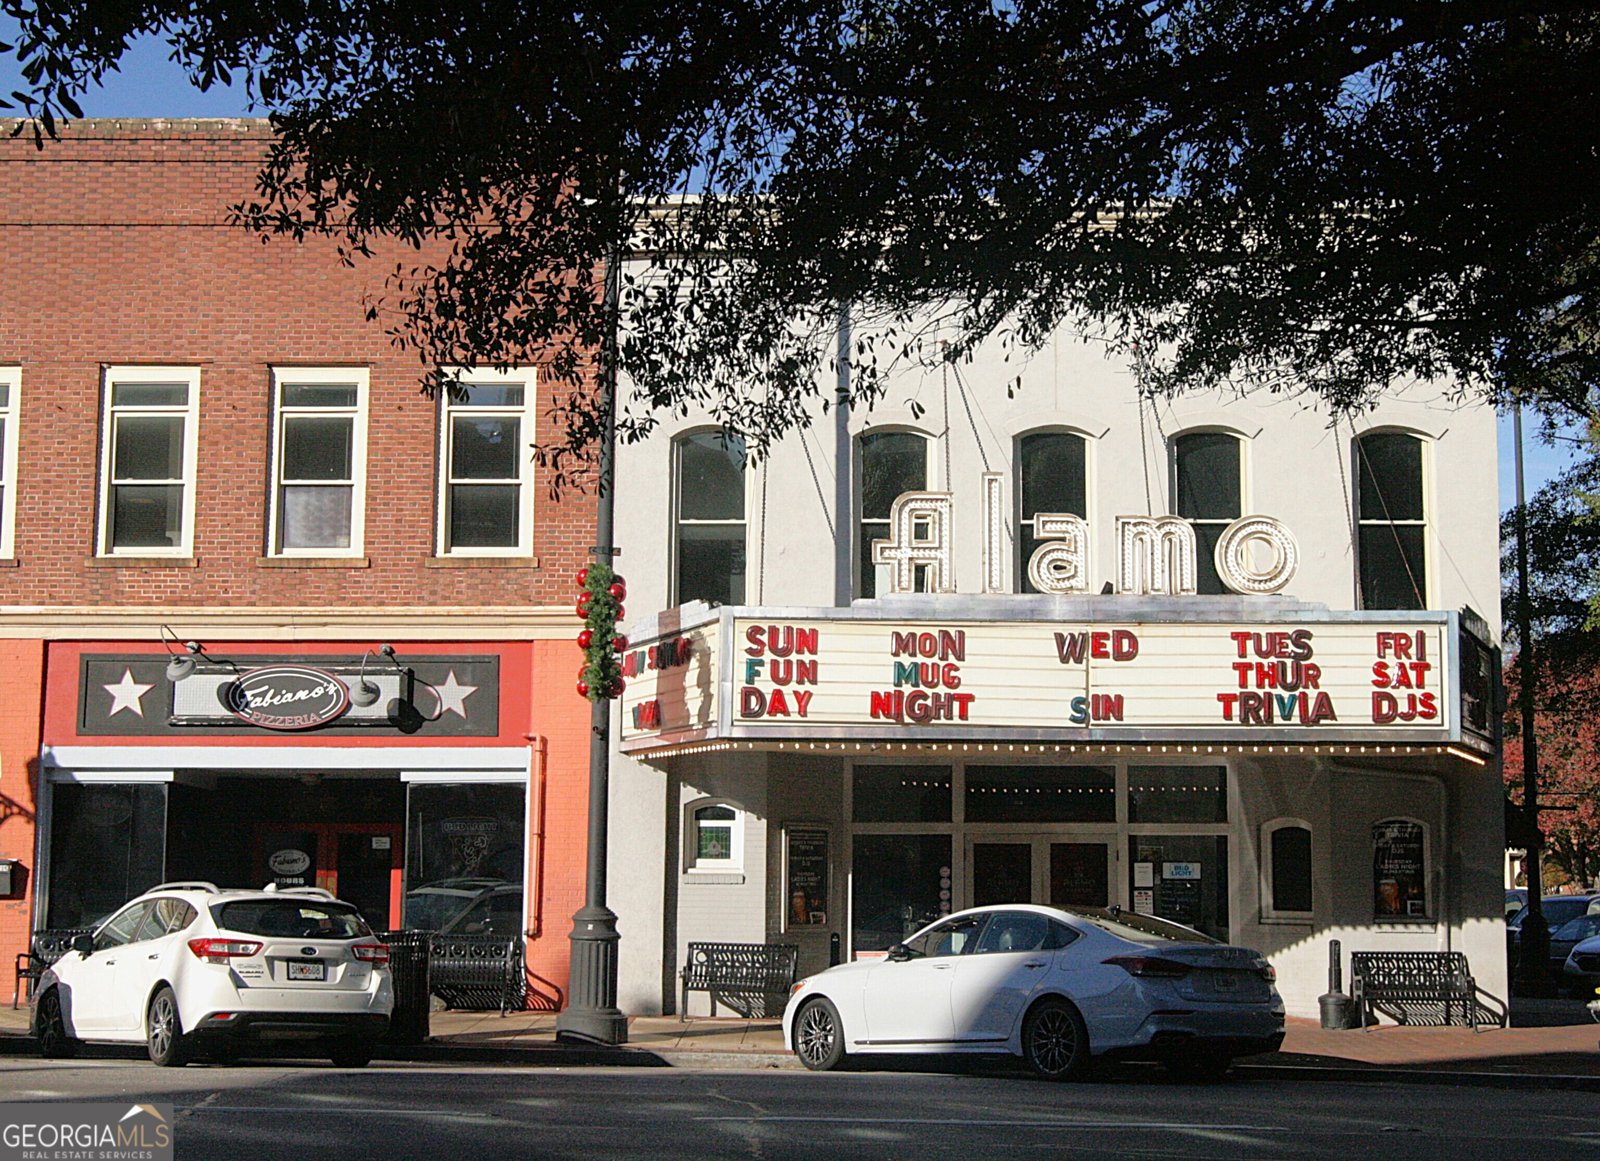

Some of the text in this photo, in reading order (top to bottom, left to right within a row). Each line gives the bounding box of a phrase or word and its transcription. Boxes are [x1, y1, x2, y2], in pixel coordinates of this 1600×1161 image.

[871, 472, 1301, 597] Alamo
[744, 624, 818, 657] SUN
[891, 629, 966, 662] MON
[1053, 629, 1139, 664] WED
[1230, 629, 1313, 661] TUES
[1376, 630, 1427, 662] FRI
[745, 658, 818, 686] FUN
[893, 660, 961, 690] MUG
[1232, 660, 1322, 692] THUR
[1371, 661, 1432, 690] SAT
[240, 682, 338, 711] Fabiano's
[740, 687, 814, 719] DAY
[870, 690, 975, 724] NIGHT
[1068, 693, 1124, 724] SIN
[1217, 691, 1338, 725] TRIVIA
[1371, 691, 1438, 724] DJS
[249, 711, 322, 727] PIZZERIA
